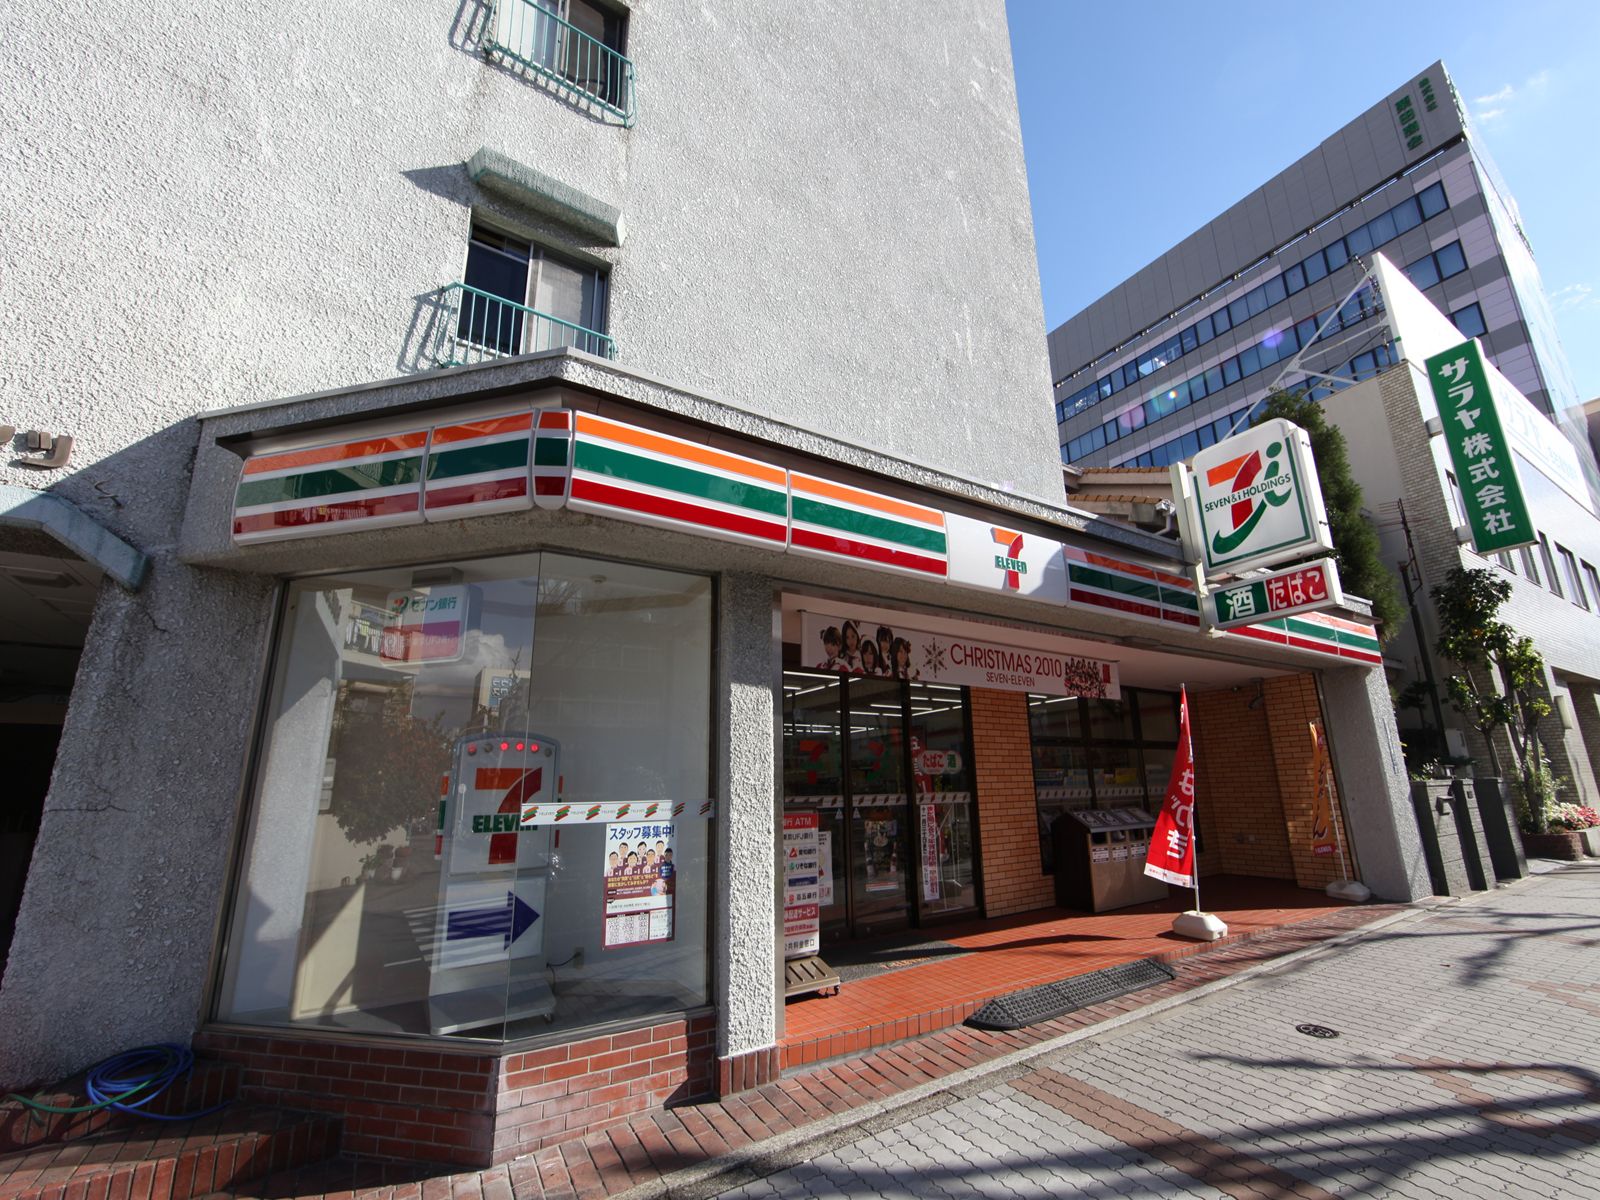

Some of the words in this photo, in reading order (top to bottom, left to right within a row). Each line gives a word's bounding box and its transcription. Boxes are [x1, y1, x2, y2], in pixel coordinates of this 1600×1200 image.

[1438, 356, 1516, 536] サラヤ株式会社
[1242, 473, 1292, 499] HOLDINGS
[1225, 585, 1256, 620] 酒
[1269, 570, 1326, 611] たばこ
[950, 643, 1032, 674] CHRISTMAS
[1034, 656, 1062, 678] 2010
[795, 817, 812, 826] ATM
